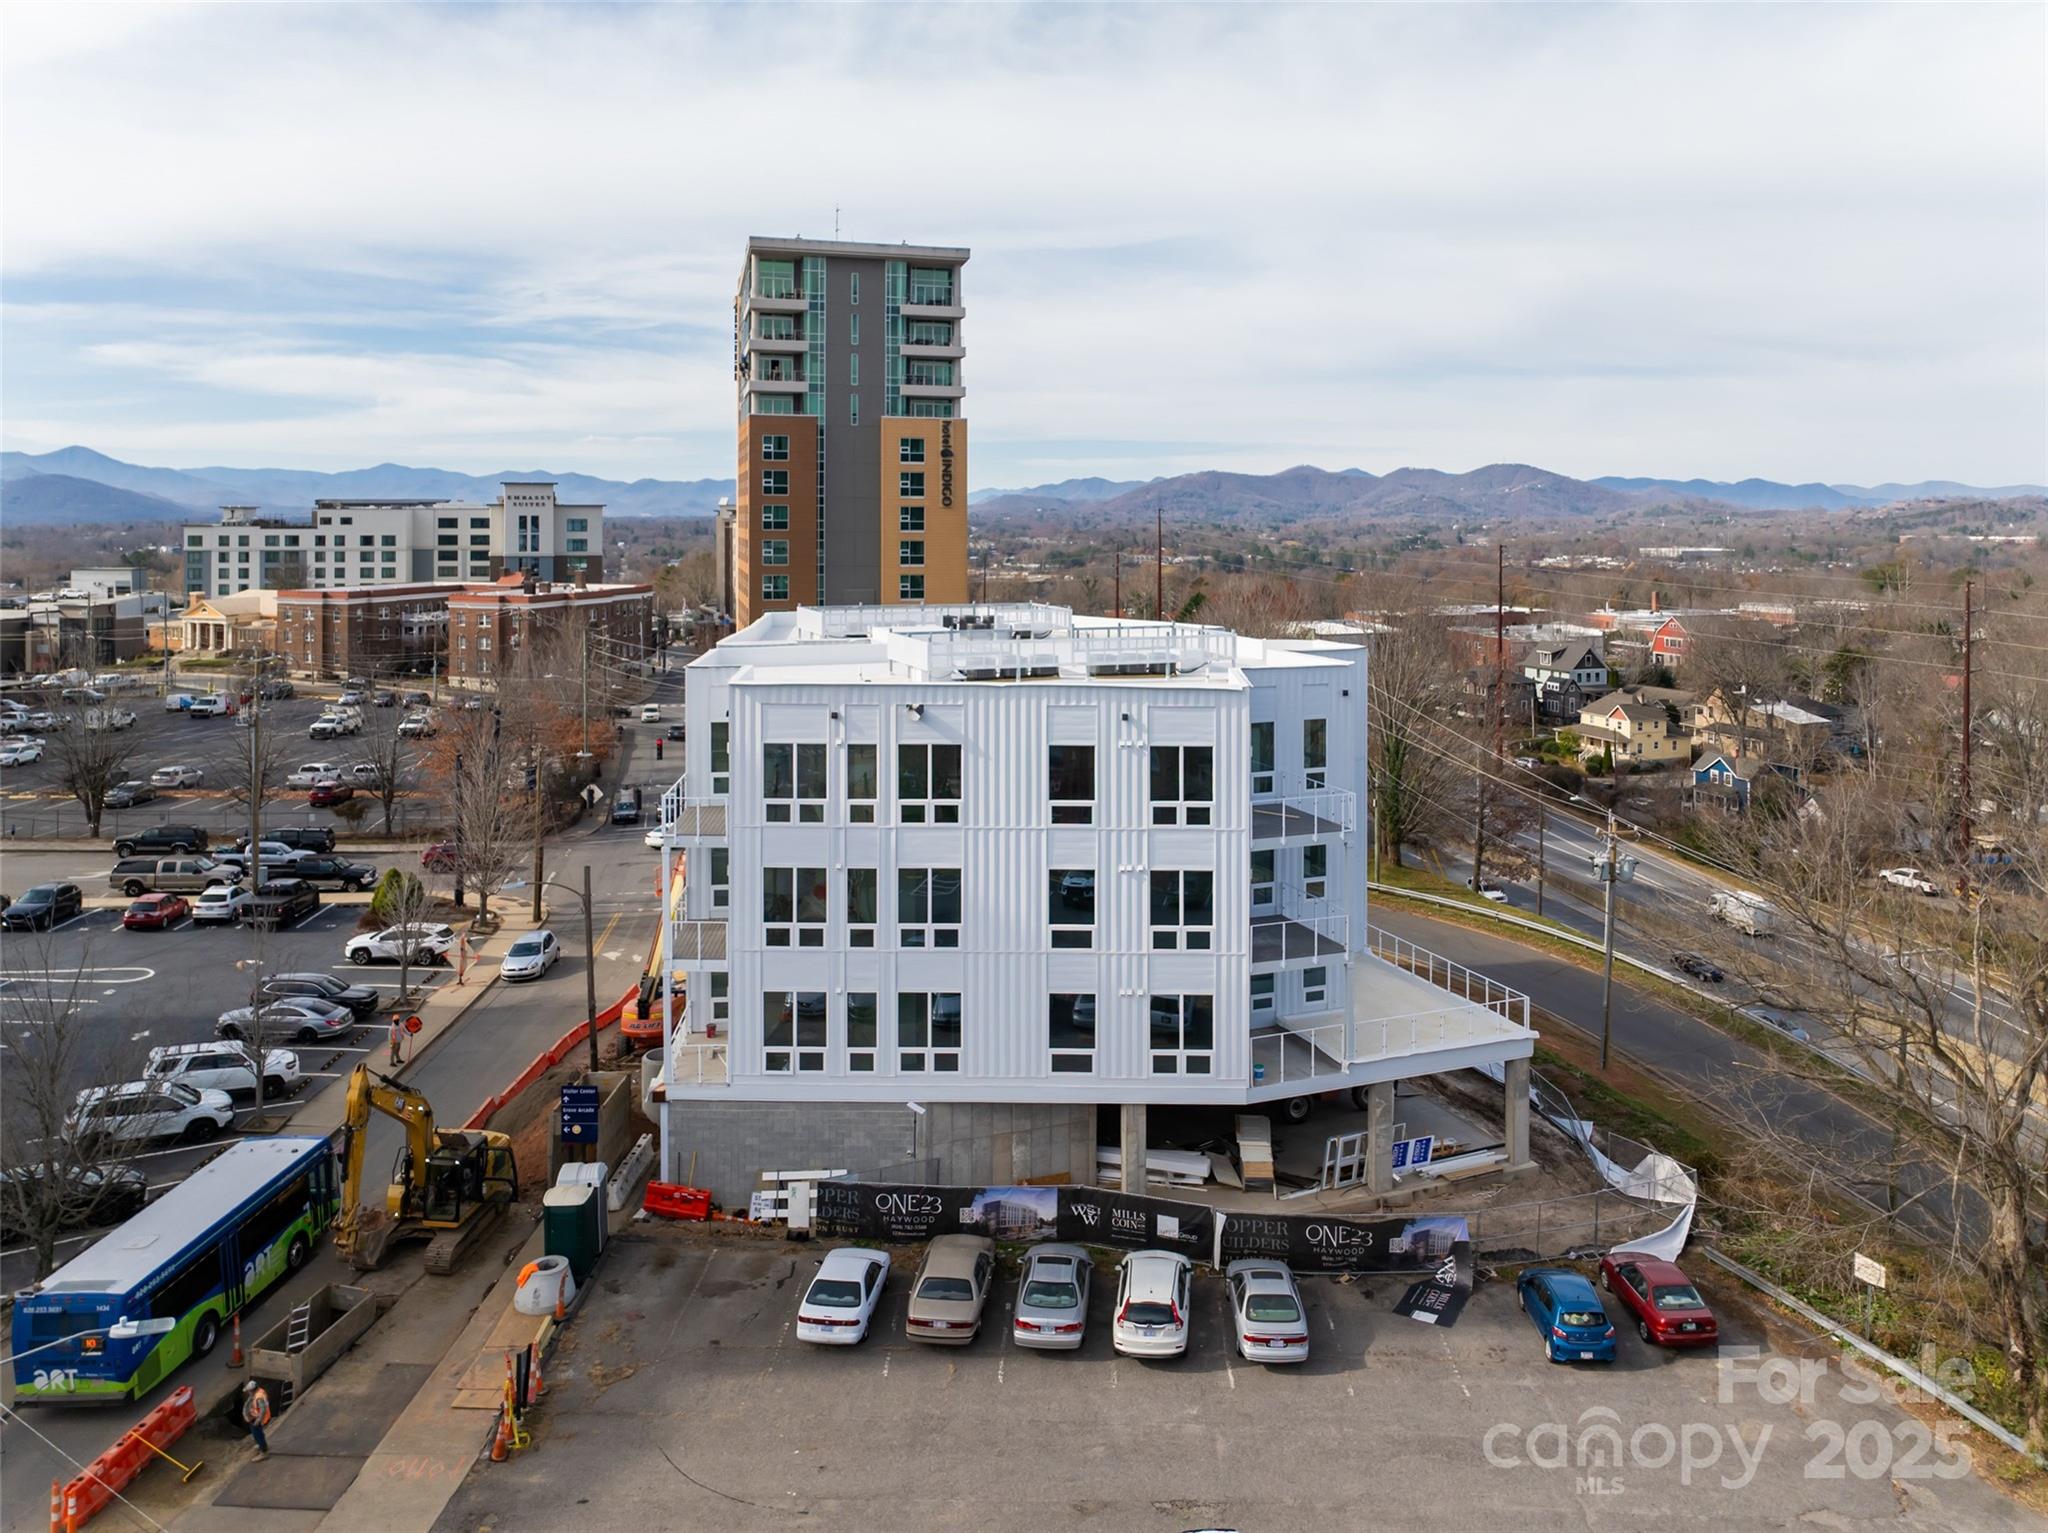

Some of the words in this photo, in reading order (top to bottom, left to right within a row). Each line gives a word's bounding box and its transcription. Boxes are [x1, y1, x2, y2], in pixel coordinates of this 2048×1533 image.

[942, 420, 952, 448] hotel
[941, 459, 953, 507] INDIGO
[875, 1193, 943, 1214] ONE23
[882, 1215, 936, 1223] HAYWOOD
[1111, 1208, 1147, 1221] MILLS
[1111, 1218, 1138, 1229] COIN
[1305, 1224, 1374, 1247] ONE23
[1313, 1247, 1365, 1256] HAYWOOD
